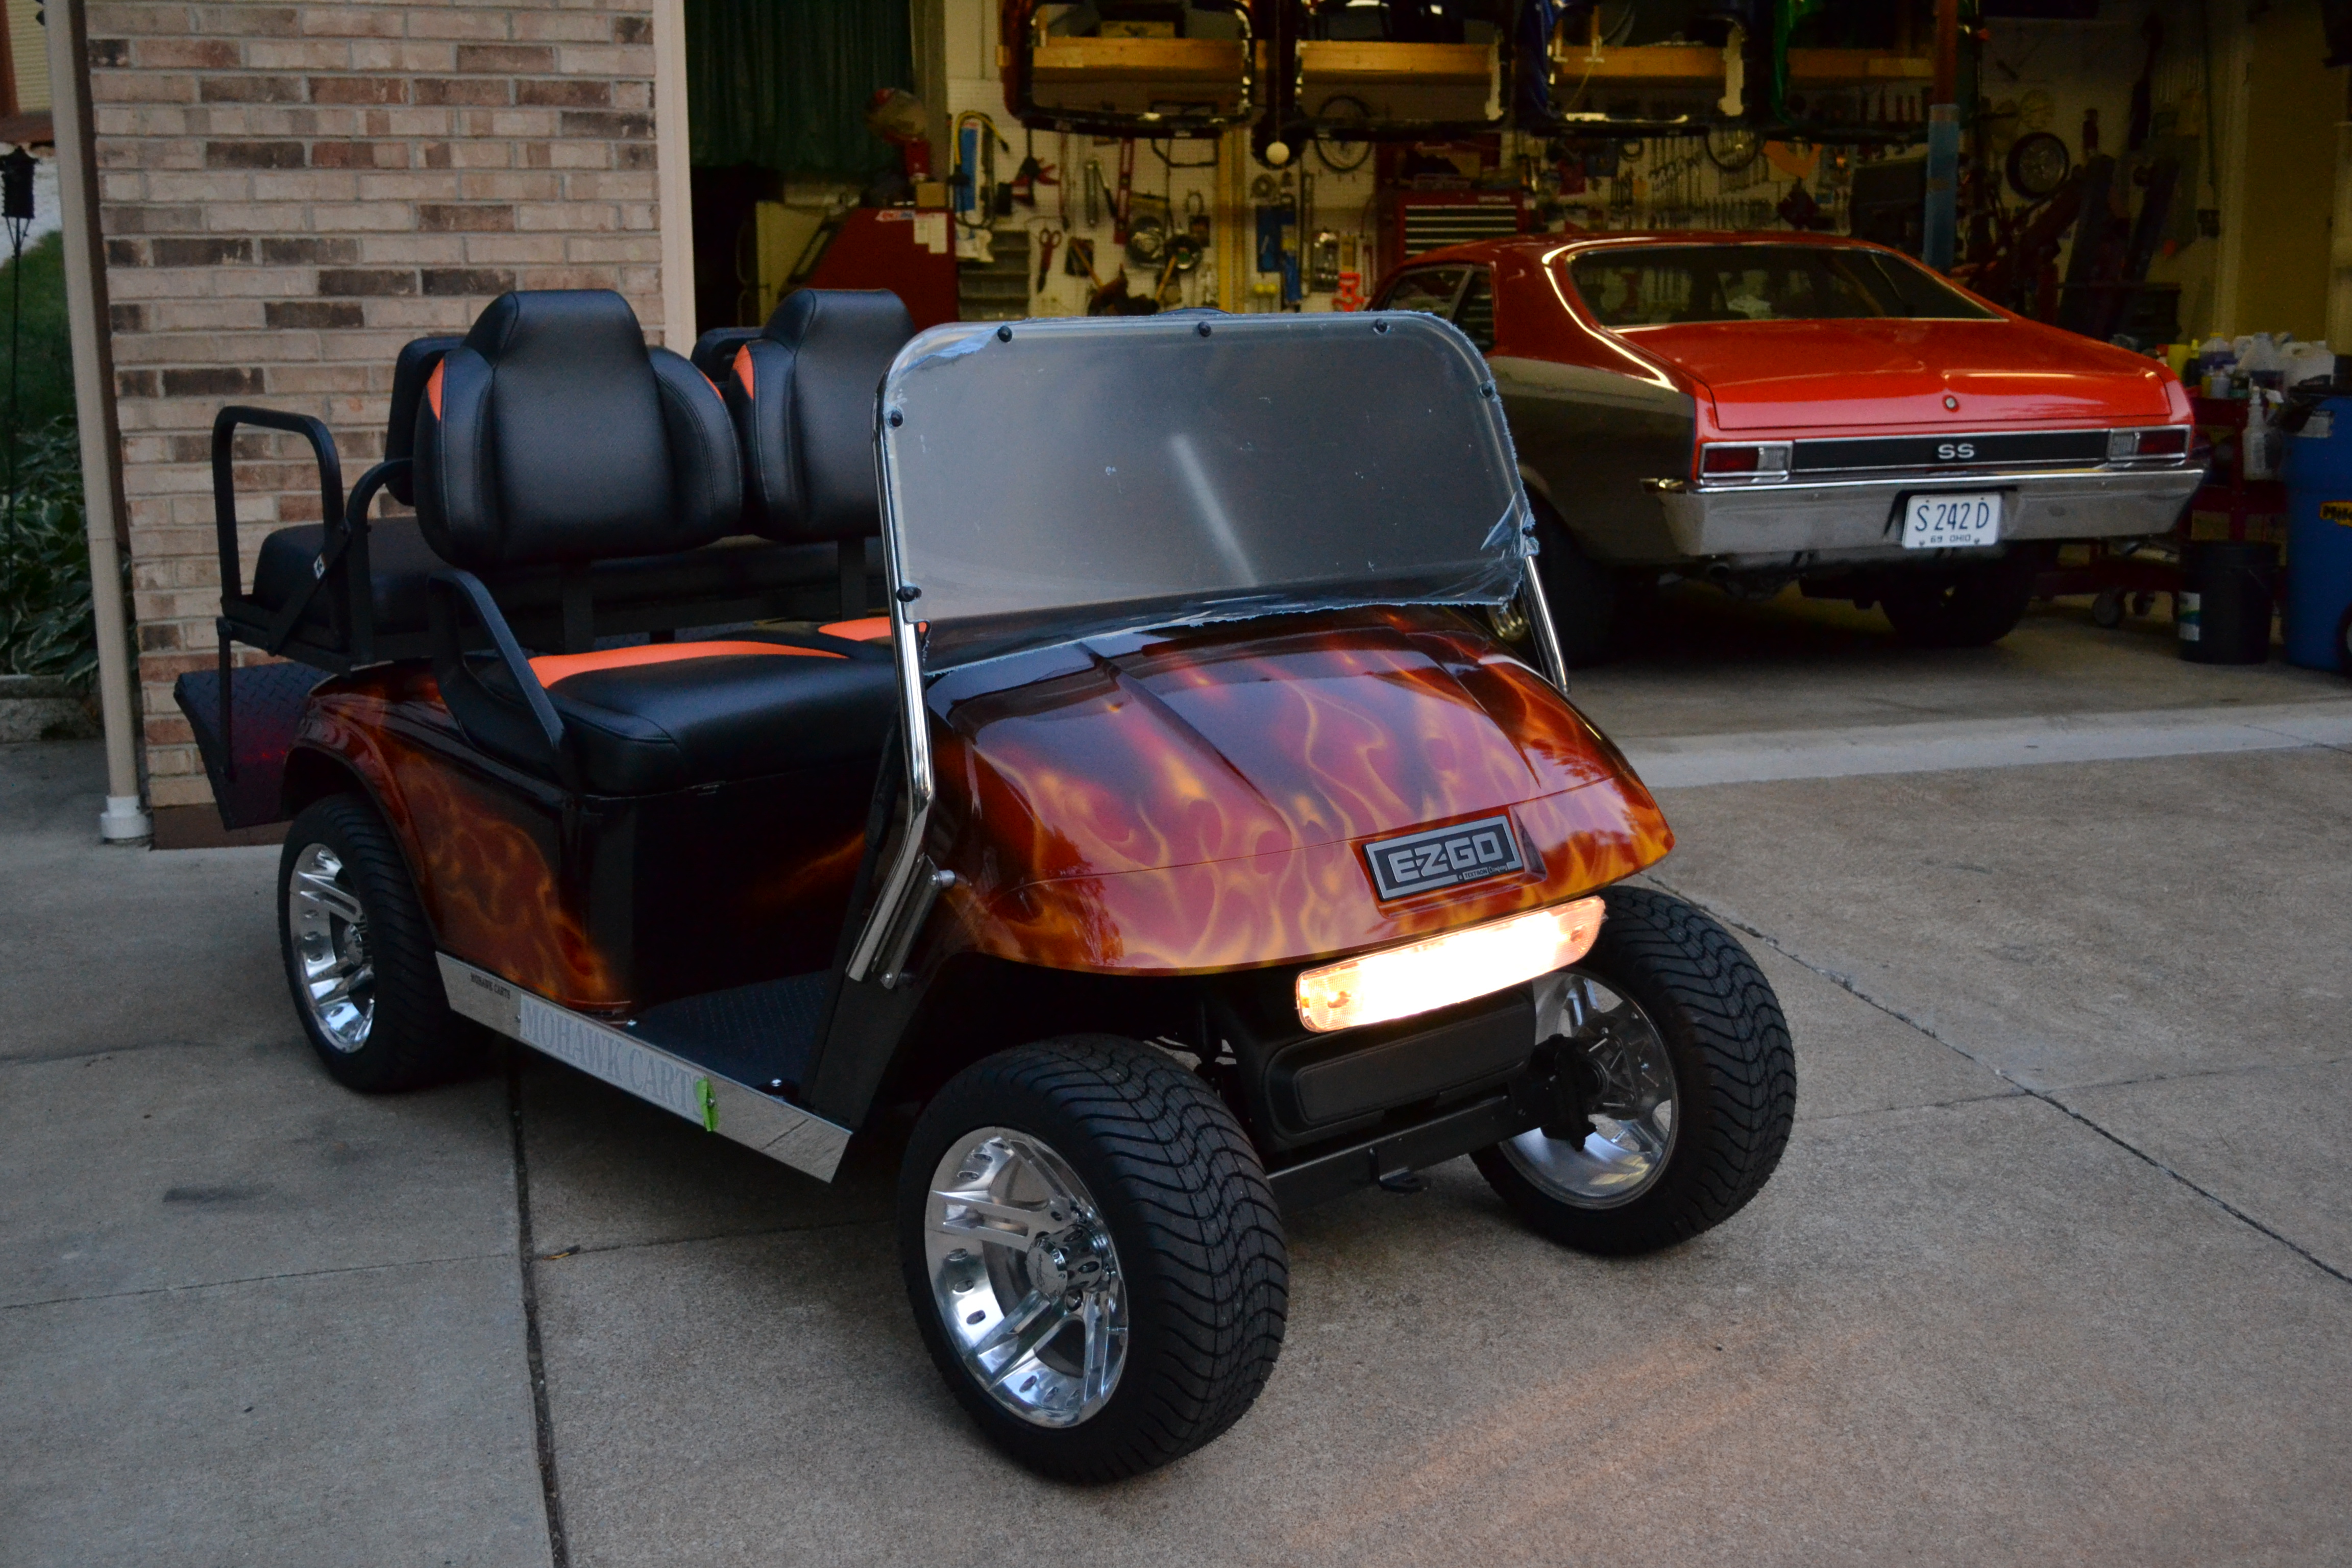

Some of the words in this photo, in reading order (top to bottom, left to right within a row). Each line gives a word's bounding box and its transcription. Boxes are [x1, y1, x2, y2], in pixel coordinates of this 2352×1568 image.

[1938, 443, 1975, 459] SS
[1915, 504, 1929, 531] S
[1934, 502, 1970, 531] 242
[1976, 502, 1990, 529] D
[1949, 534, 1971, 543] OHIO
[1464, 868, 1487, 878] TEXTRON
[494, 984, 510, 1000] CARTS
[522, 999, 623, 1085] MOHAWK
